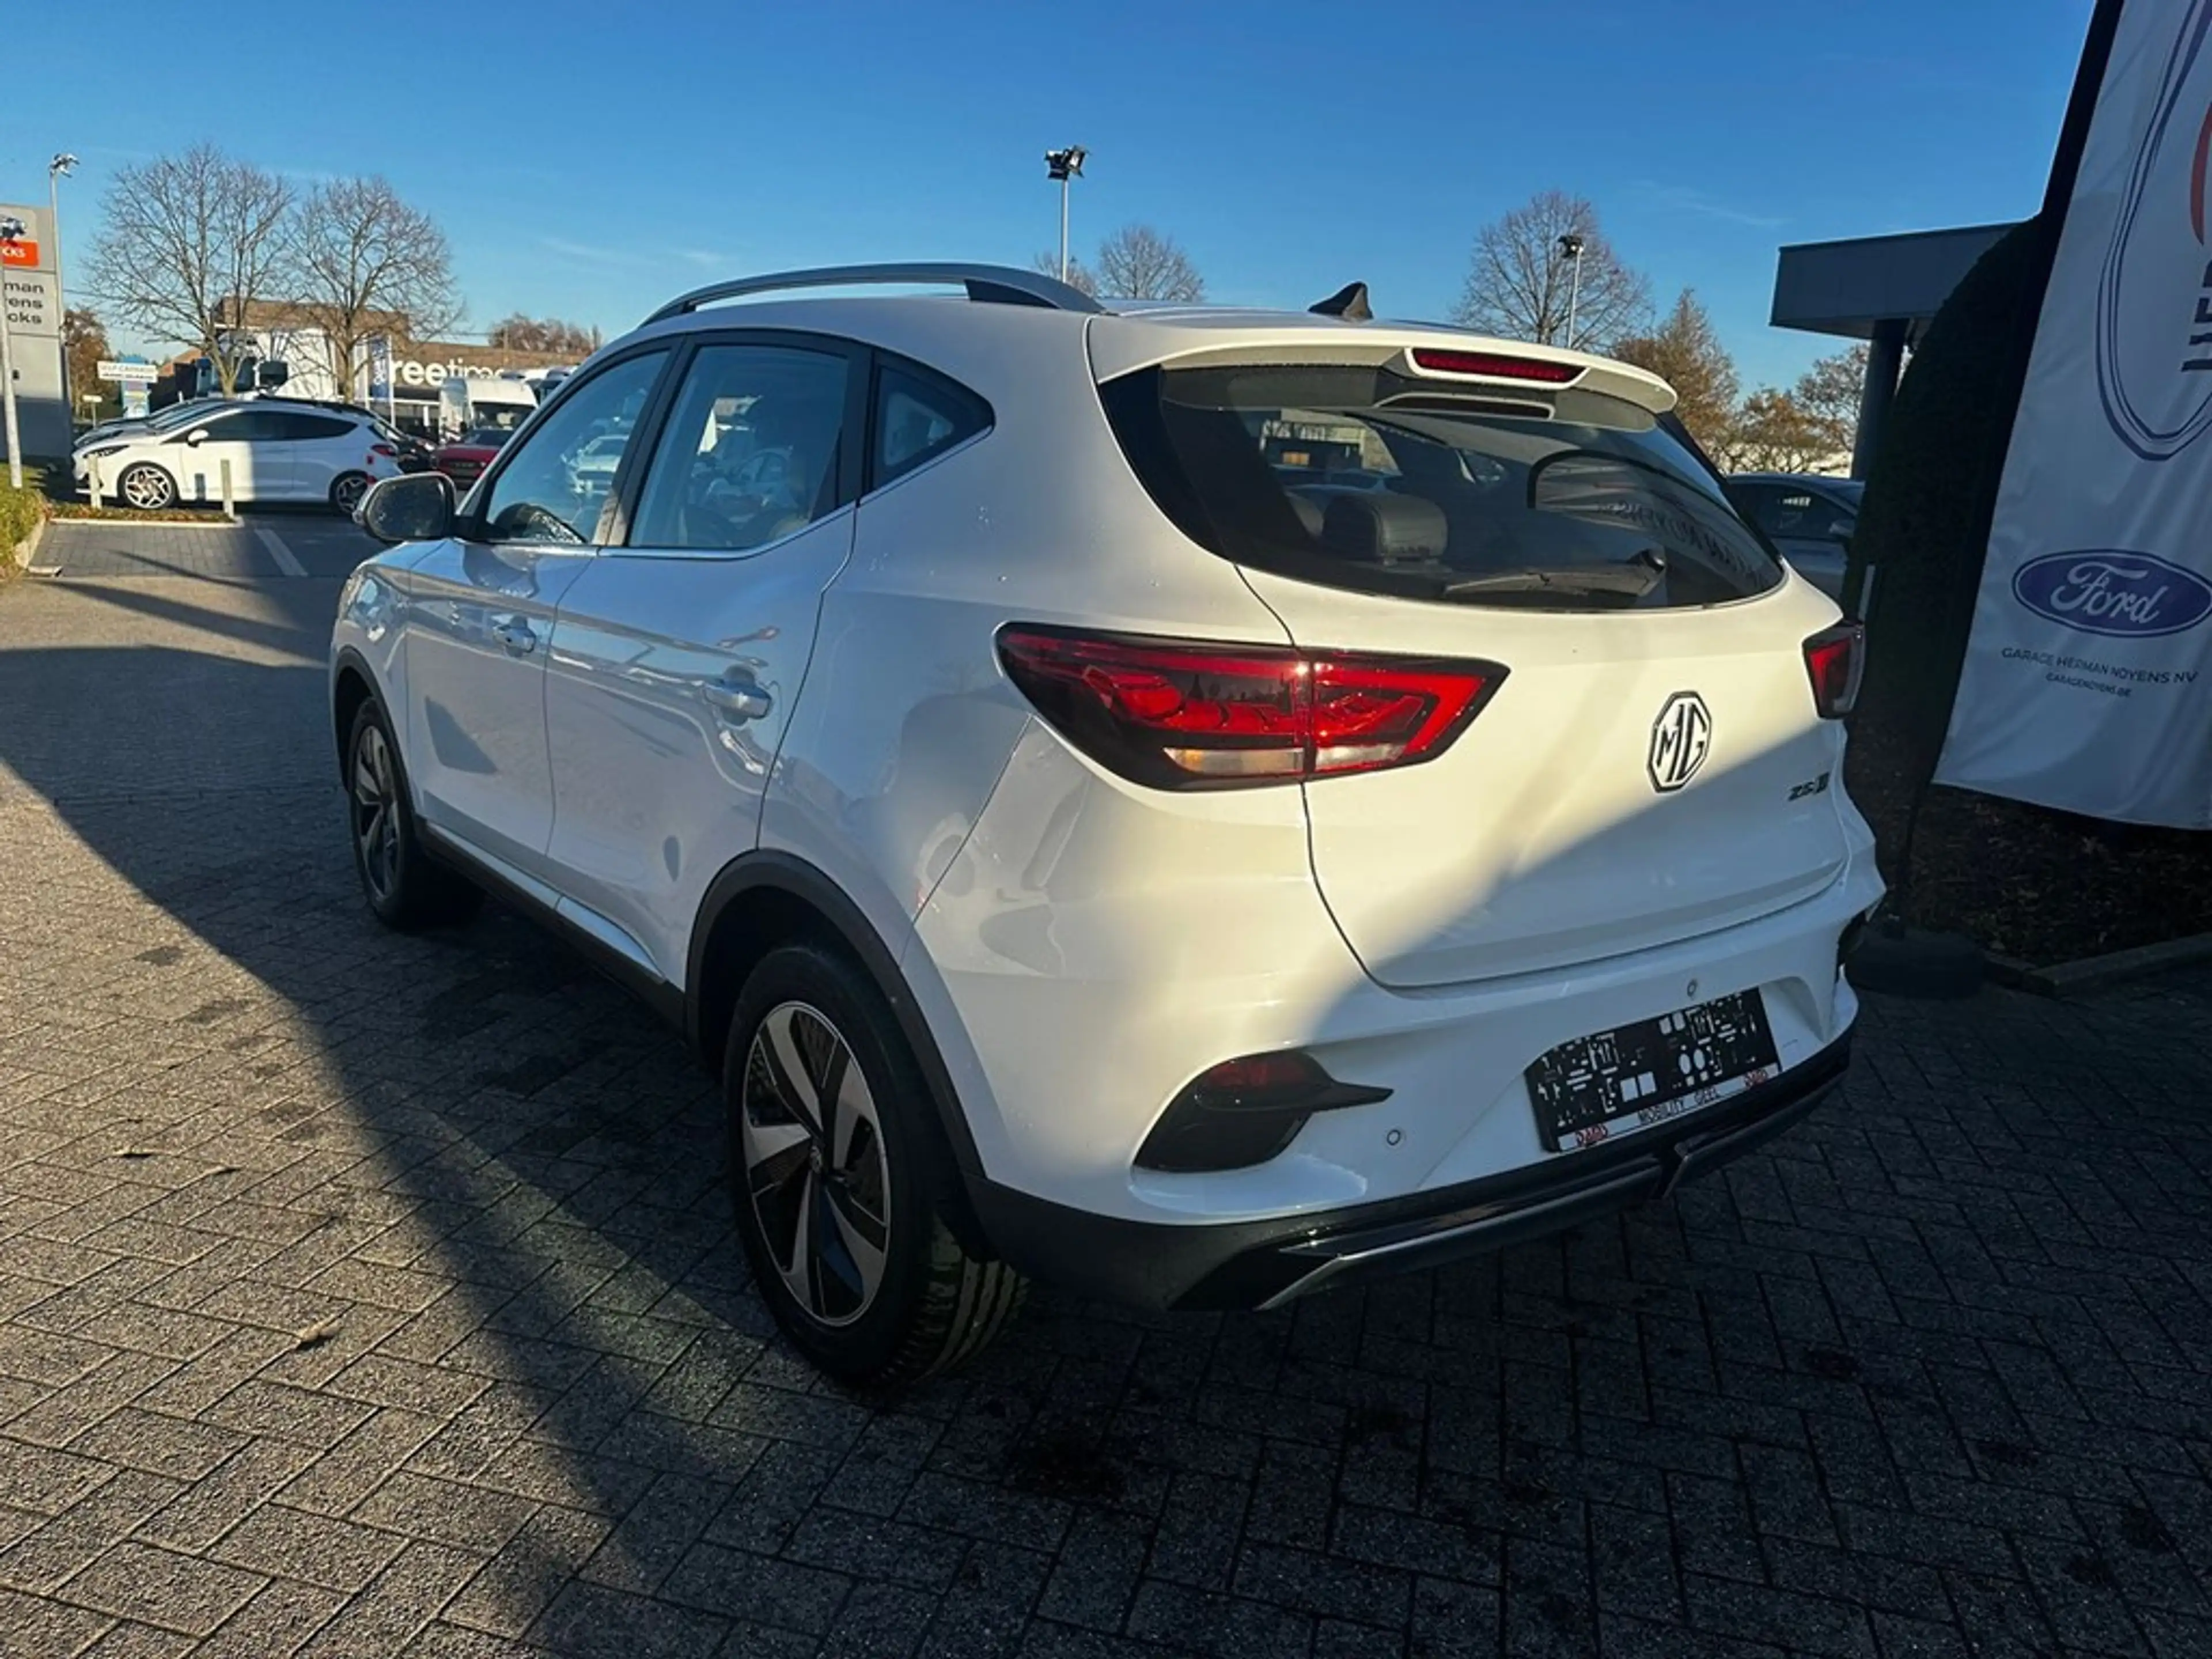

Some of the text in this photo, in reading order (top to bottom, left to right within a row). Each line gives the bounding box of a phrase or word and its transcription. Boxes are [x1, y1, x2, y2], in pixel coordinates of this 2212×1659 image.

[6, 297, 43, 310] ens
[2050, 561, 2169, 624] Ford
[2001, 646, 2200, 684] GARAGE HERMAN NOYENS NV
[1656, 702, 1707, 783] MG
